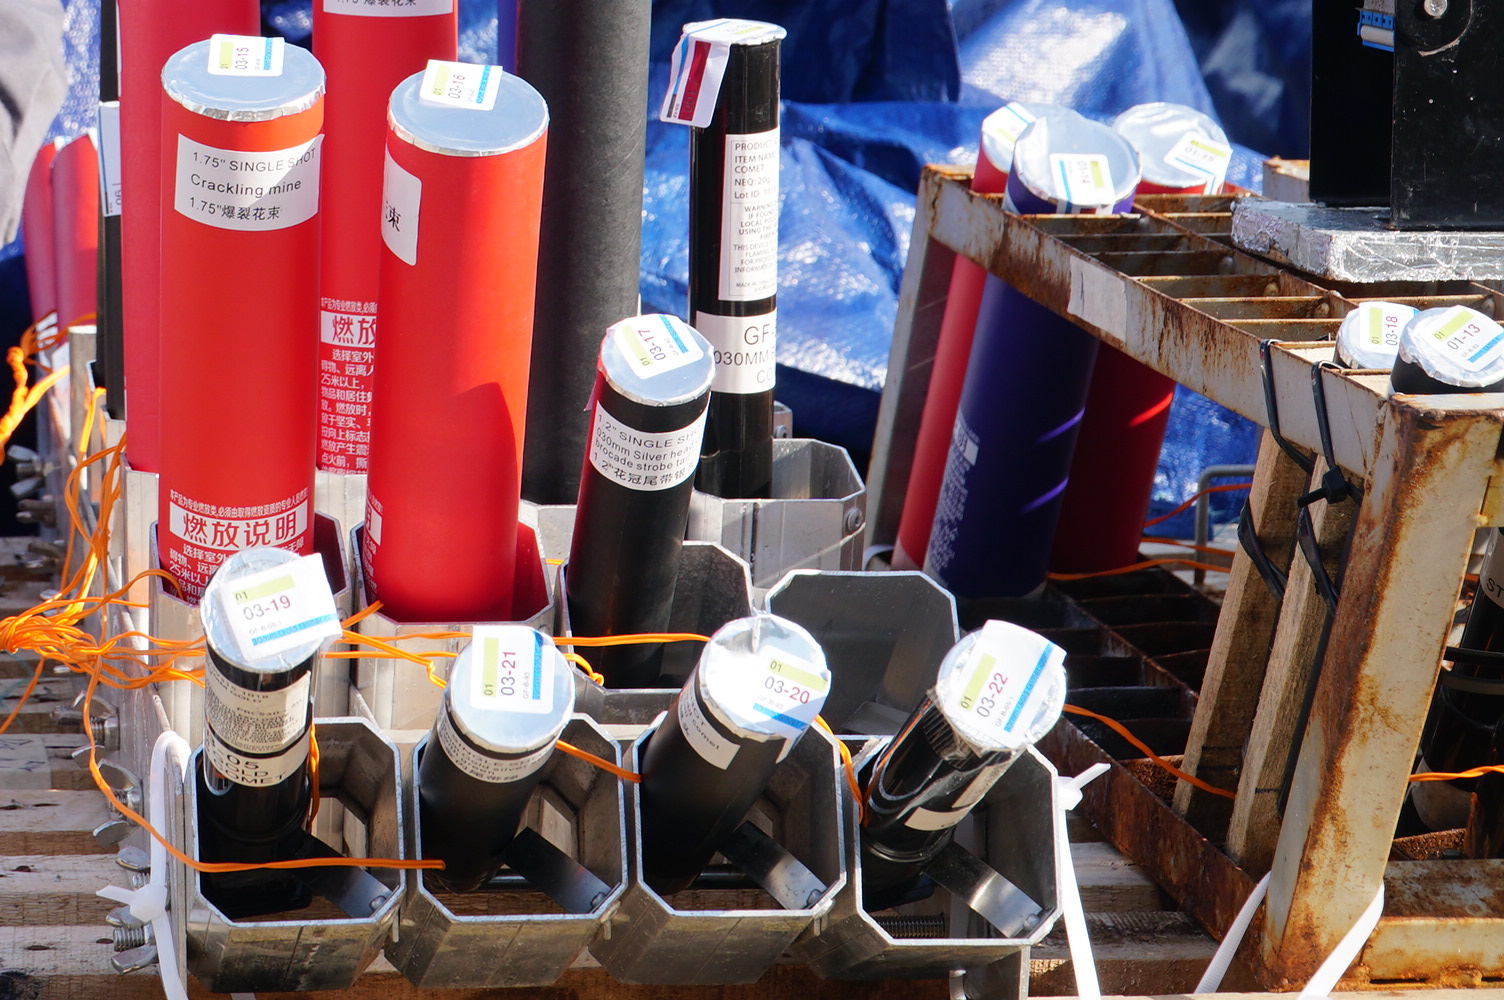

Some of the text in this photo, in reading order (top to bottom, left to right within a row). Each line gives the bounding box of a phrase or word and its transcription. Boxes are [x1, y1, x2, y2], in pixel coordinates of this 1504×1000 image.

[235, 46, 250, 71] 03-15
[447, 73, 466, 100] 03-16
[192, 147, 316, 173] 1.75" SINGLE SHOT
[734, 164, 764, 174] COMET
[735, 155, 756, 164] ITEM
[190, 173, 302, 199] Crackling mine
[734, 191, 749, 200] Lot
[1371, 336, 1380, 345] 01
[1385, 315, 1398, 346] 03-18
[1434, 331, 1446, 340] 01
[1447, 323, 1481, 351] 01-13
[637, 329, 667, 361] 03-17
[713, 349, 769, 367] 030MM
[639, 357, 651, 366] 01
[596, 427, 631, 457] 030mm
[633, 449, 667, 462] Silver
[619, 430, 673, 449] SINGLE
[595, 438, 634, 469] brocade
[636, 461, 674, 472] strobe
[183, 511, 298, 549] 燃放说明
[243, 594, 292, 621] 03-19
[500, 651, 517, 696] 03-21
[769, 660, 783, 673] 01
[484, 683, 494, 696] 01
[764, 676, 811, 705] 03-20
[960, 695, 973, 709] 01
[976, 672, 1009, 719] 03-22
